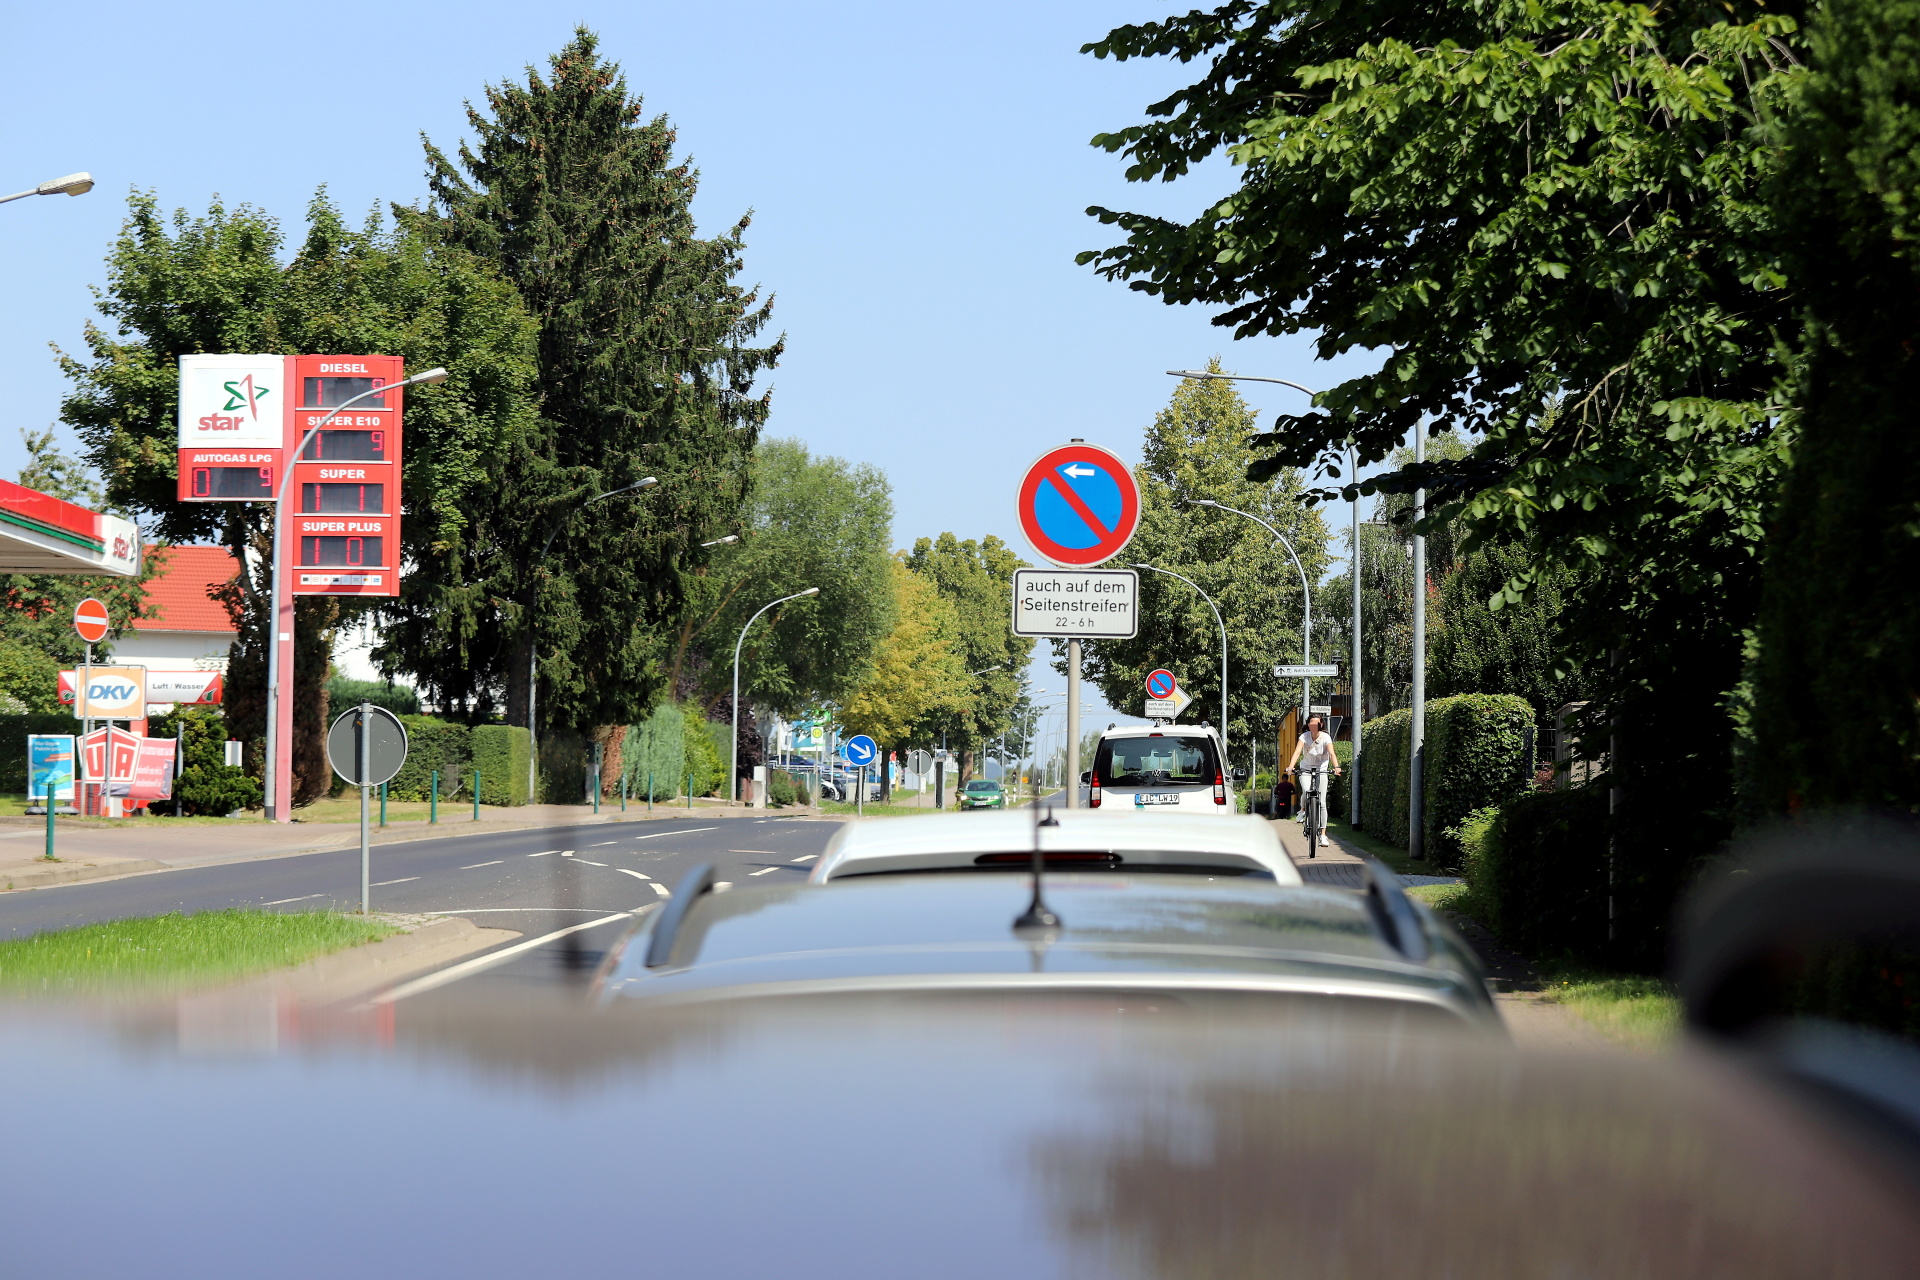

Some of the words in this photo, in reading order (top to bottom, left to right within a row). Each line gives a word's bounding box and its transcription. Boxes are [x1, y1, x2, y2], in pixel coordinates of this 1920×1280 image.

[320, 363, 369, 373] DIESEL
[198, 412, 244, 431] star
[356, 416, 380, 426] E10
[371, 431, 384, 451] 9
[193, 454, 247, 463] AUTOGAS
[249, 454, 272, 463] LPG
[320, 469, 365, 479] SUPER
[192, 467, 210, 498] 0
[259, 467, 272, 487] 9
[302, 522, 345, 532] SUPER
[348, 522, 382, 532] PLUS
[113, 533, 129, 560] star
[1026, 579, 1061, 592] auch
[1065, 579, 1090, 593] auf
[1094, 580, 1126, 593] dem
[1024, 597, 1127, 612] Seitenstreifen
[1055, 616, 1068, 627] 22
[1078, 617, 1085, 627] 6
[1088, 617, 1095, 627] h
[152, 682, 169, 690] Luft
[174, 682, 205, 690] Wasser
[88, 684, 136, 700] DKV
[1140, 794, 1154, 803] EIC
